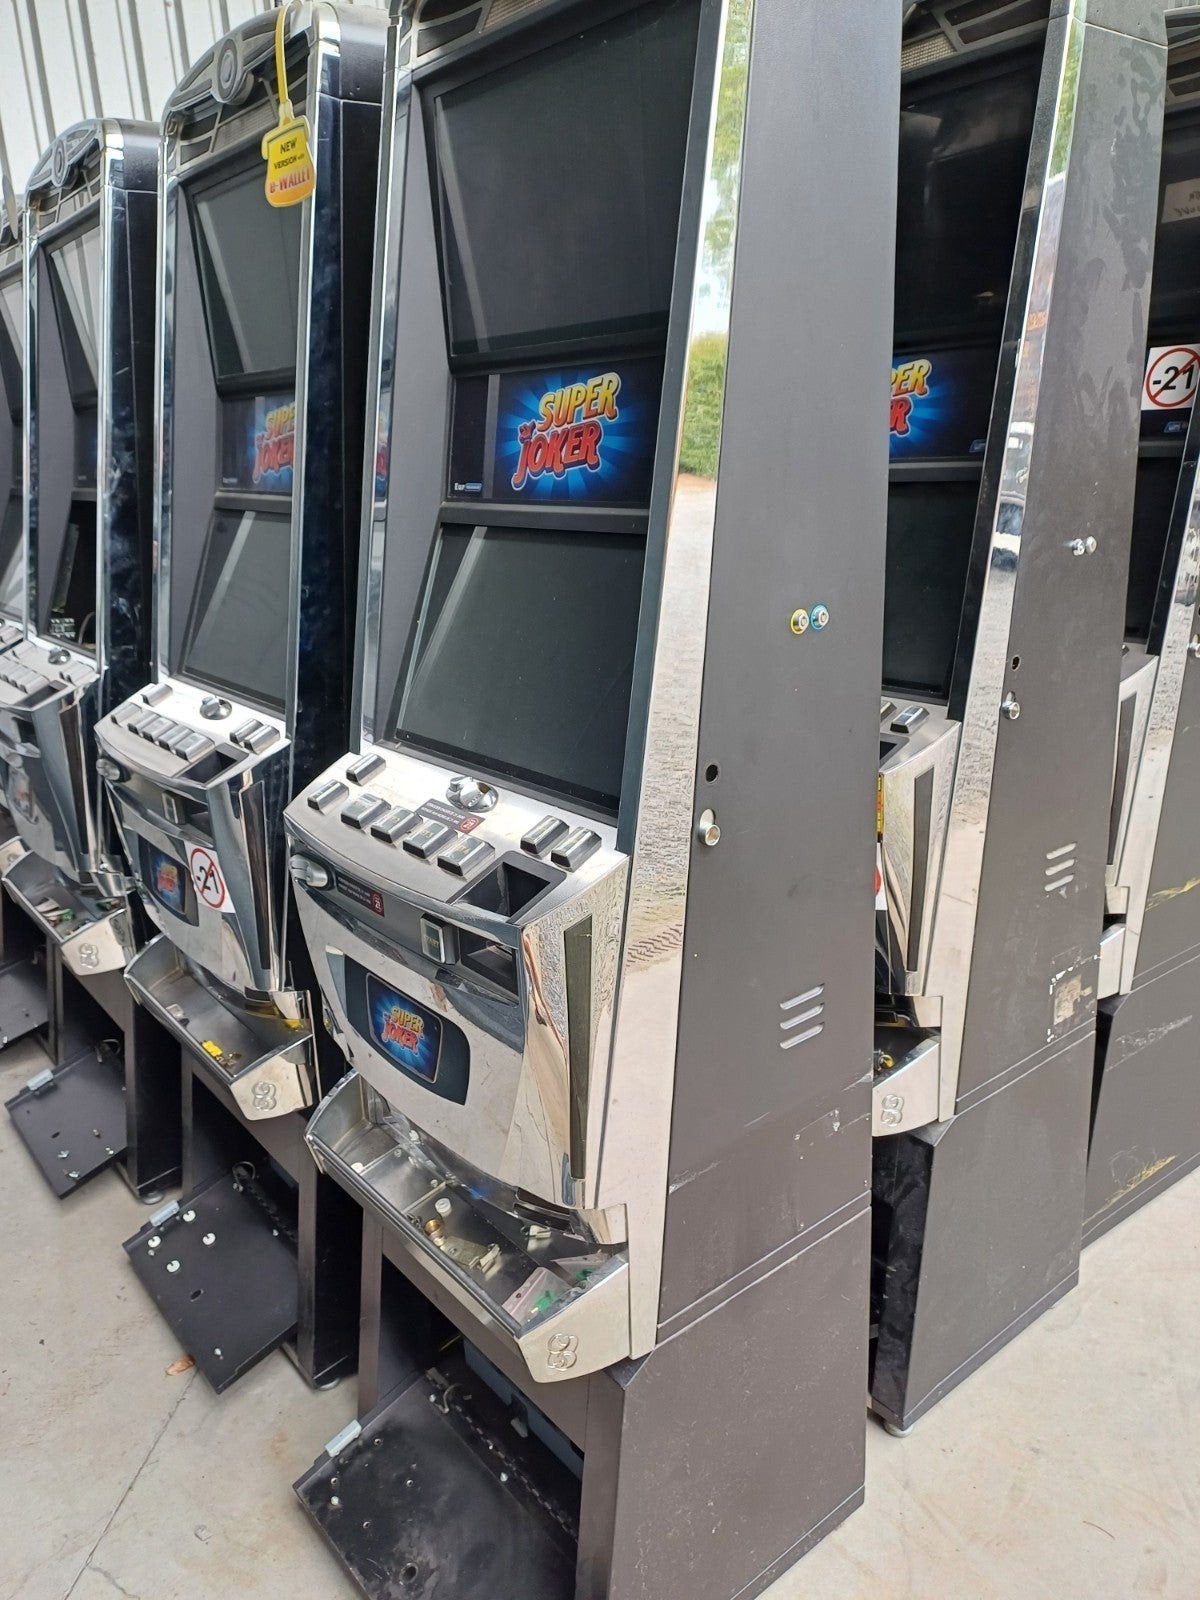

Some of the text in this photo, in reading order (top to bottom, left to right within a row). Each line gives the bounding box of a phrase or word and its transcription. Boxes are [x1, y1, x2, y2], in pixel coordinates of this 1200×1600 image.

[280, 138, 298, 154] NEW
[273, 155, 297, 169] VERSION
[1153, 364, 1195, 390] -21
[538, 372, 620, 432] SUPER
[252, 427, 295, 483] JOKE
[512, 420, 602, 490] JOKER
[196, 865, 219, 894] -21
[381, 1012, 419, 1056] JOKER
[391, 1006, 425, 1037] SUPER
